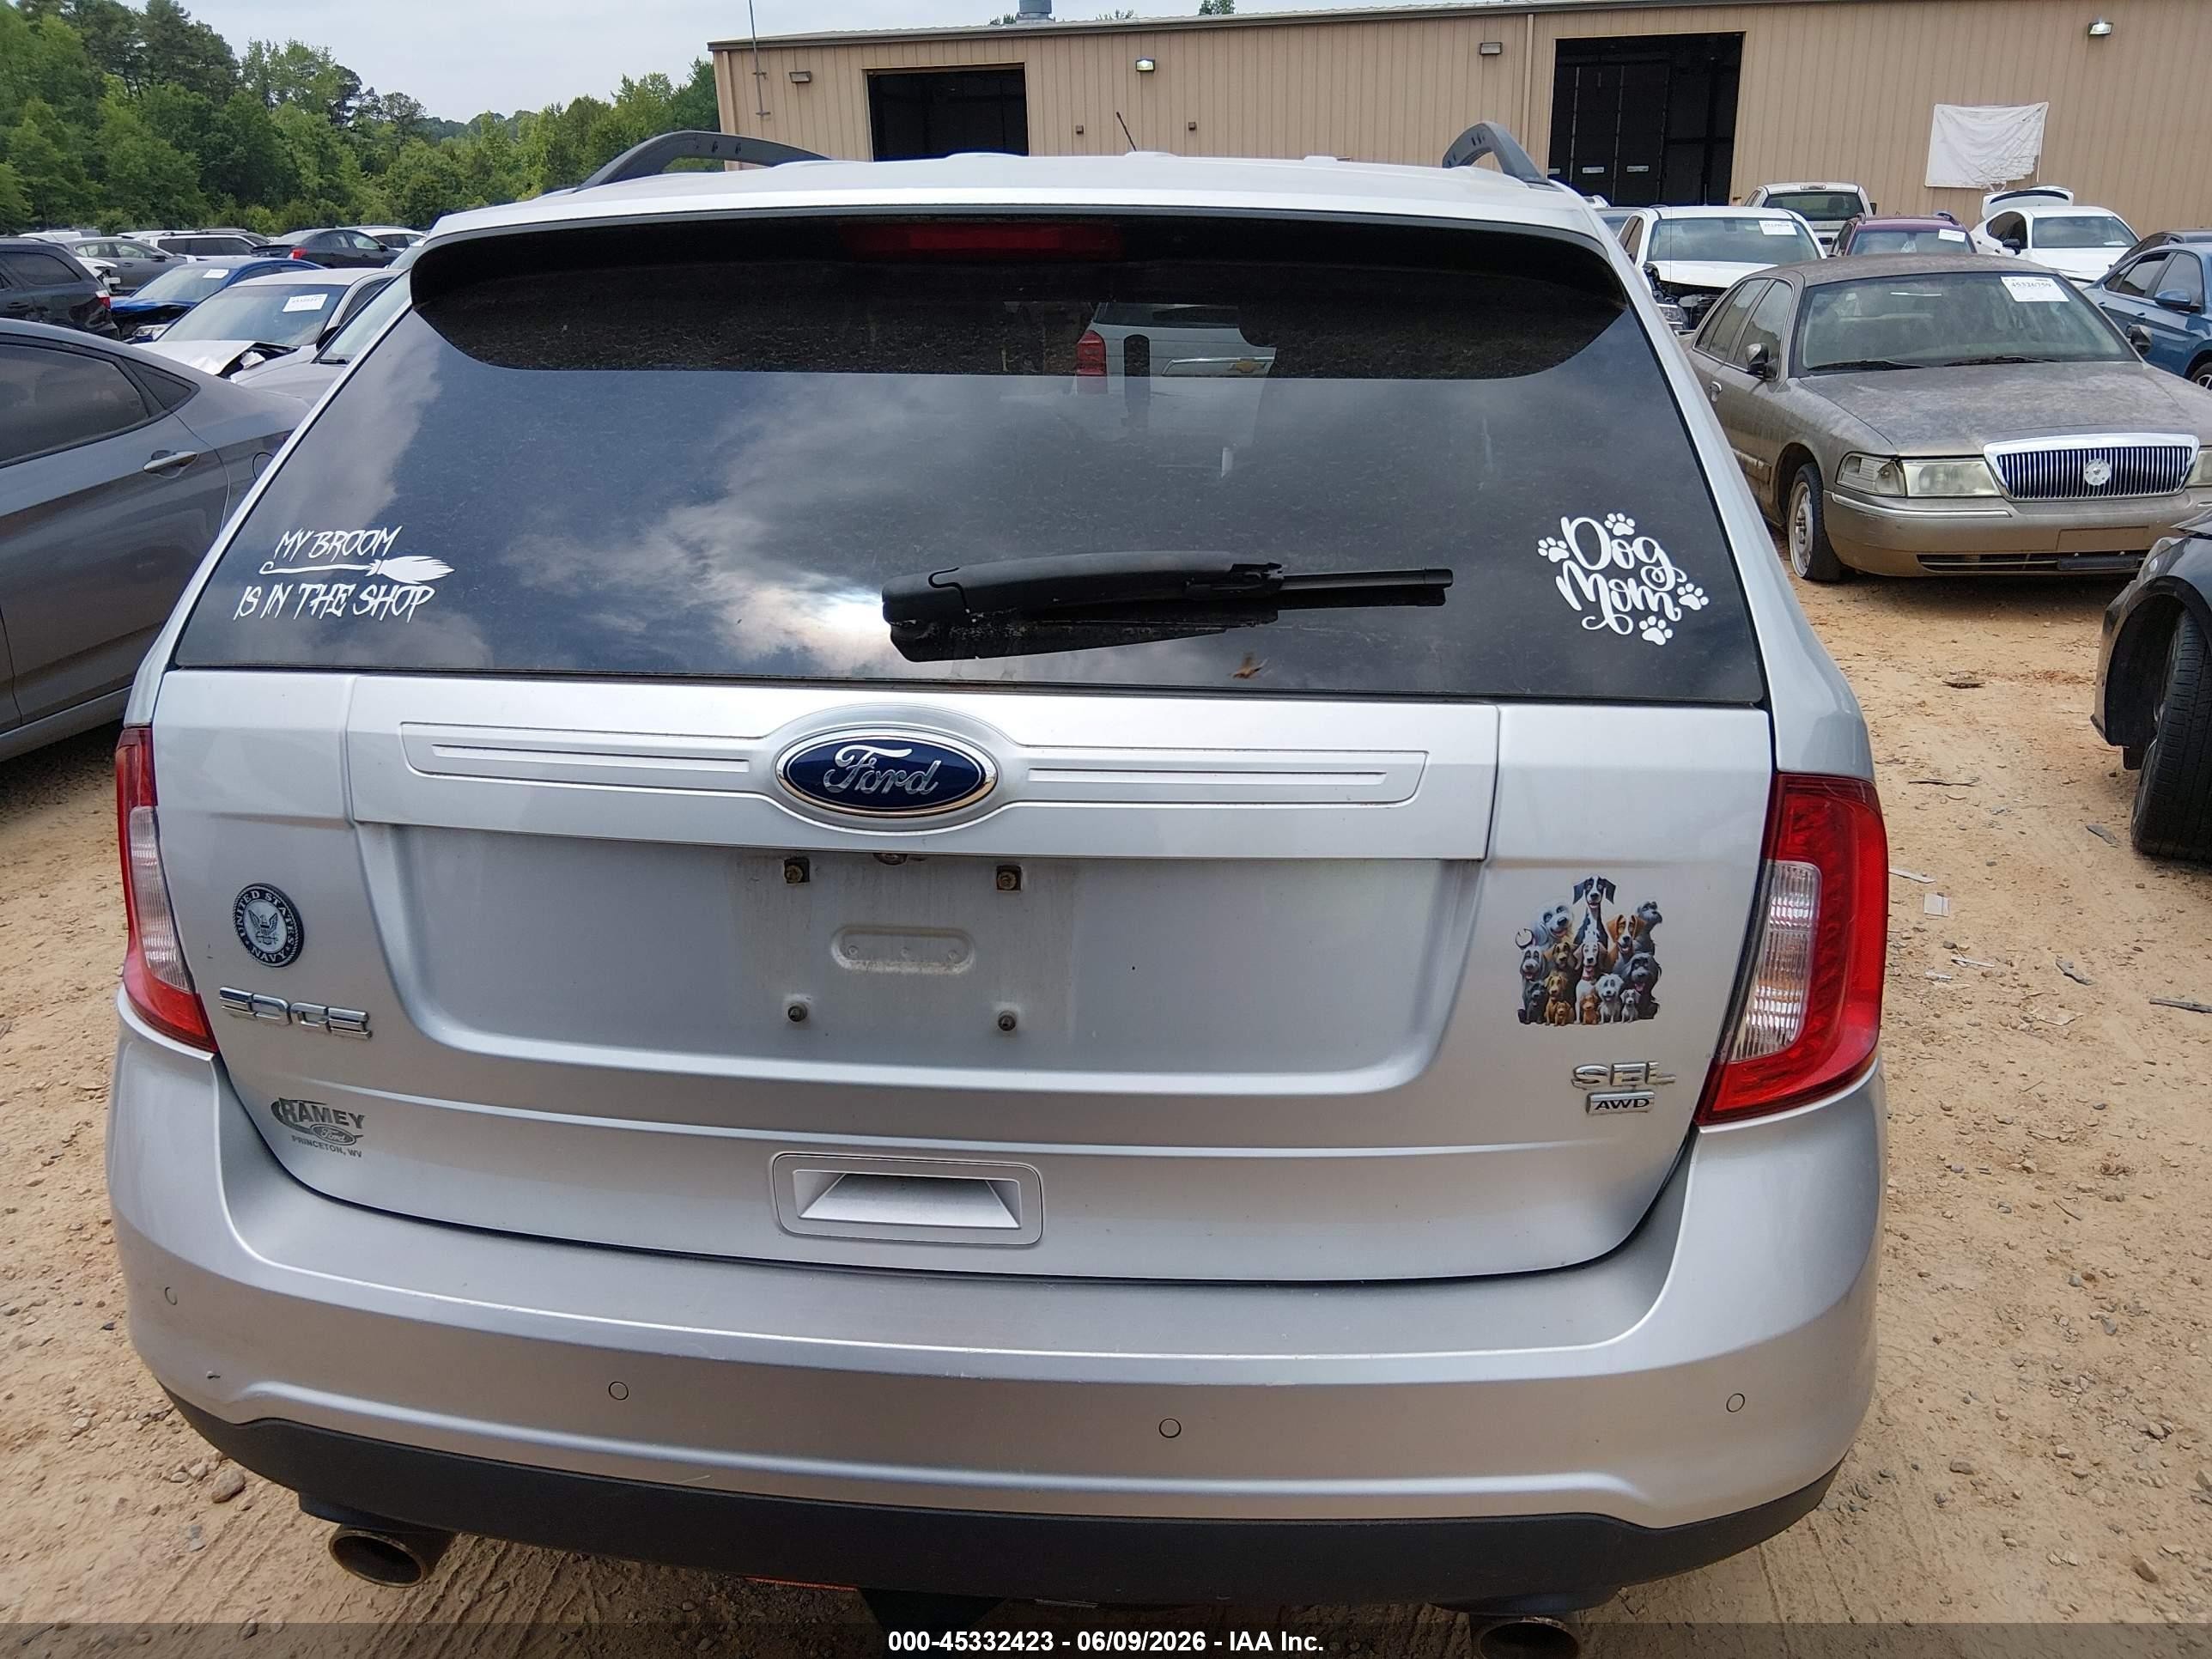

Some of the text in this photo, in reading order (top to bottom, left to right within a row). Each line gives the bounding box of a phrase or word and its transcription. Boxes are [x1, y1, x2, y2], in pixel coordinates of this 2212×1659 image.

[274, 526, 403, 562] MY BROOM
[1560, 516, 1687, 592] Dog
[234, 582, 435, 623] IS IN THE SHOP
[1555, 560, 1682, 635] Mom
[823, 744, 941, 794] Ford
[236, 890, 295, 945] UNITED STATES
[251, 947, 287, 962] NAVY
[220, 986, 373, 1039] EDGE
[1571, 1060, 1677, 1090] SEL
[278, 1097, 366, 1129] RAMEY
[1595, 1098, 1650, 1110] AWD
[291, 1134, 363, 1158] PRINCETON, WV
